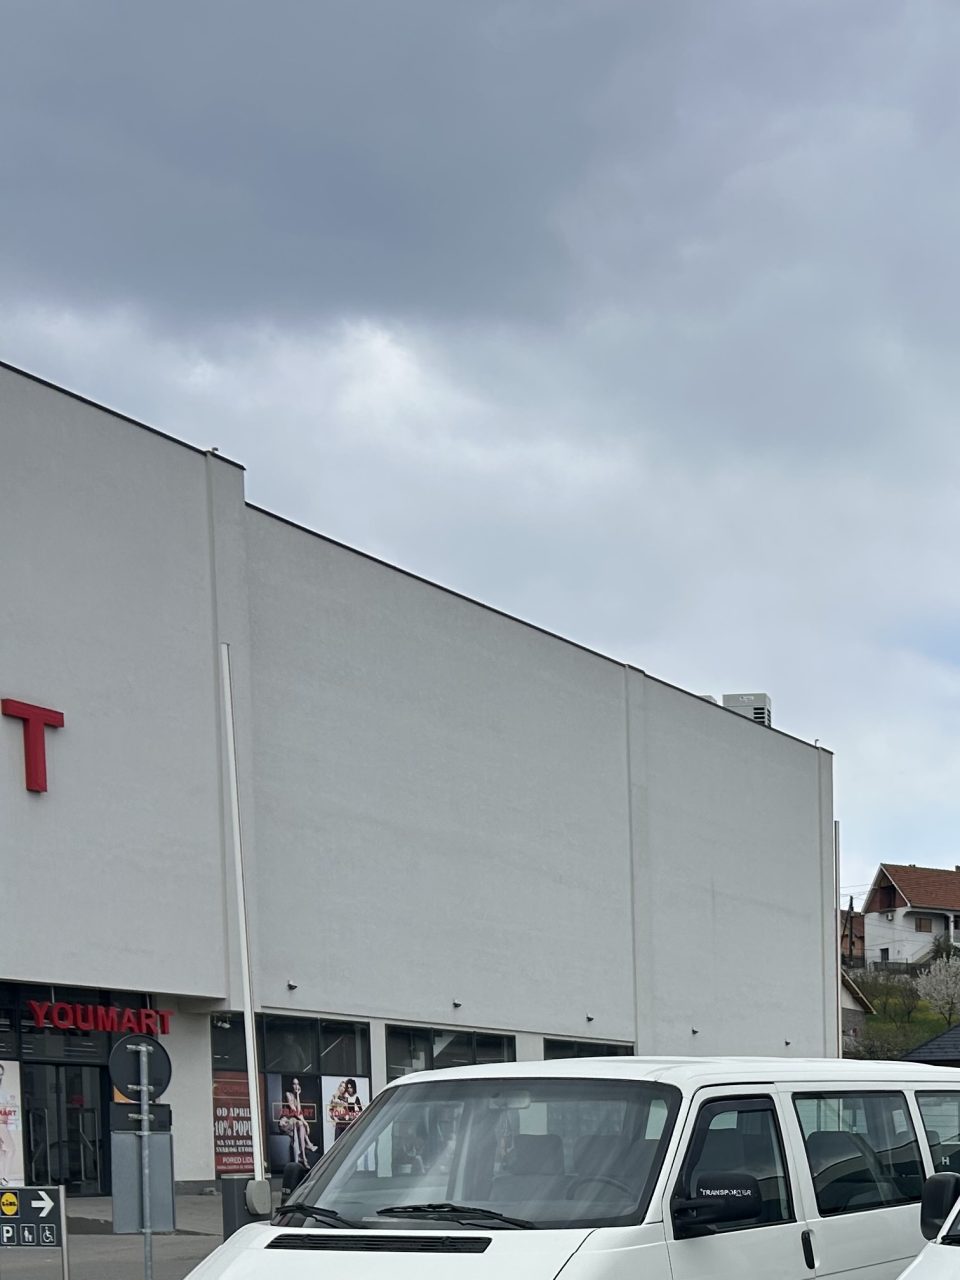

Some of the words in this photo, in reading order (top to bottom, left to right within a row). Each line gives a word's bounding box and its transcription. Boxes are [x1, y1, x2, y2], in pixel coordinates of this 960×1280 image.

[29, 1000, 174, 1034] YOUMART
[217, 1107, 228, 1117] OD
[229, 1107, 252, 1118] APRIL
[215, 1120, 232, 1136] 10%
[233, 1121, 253, 1136] POPU
